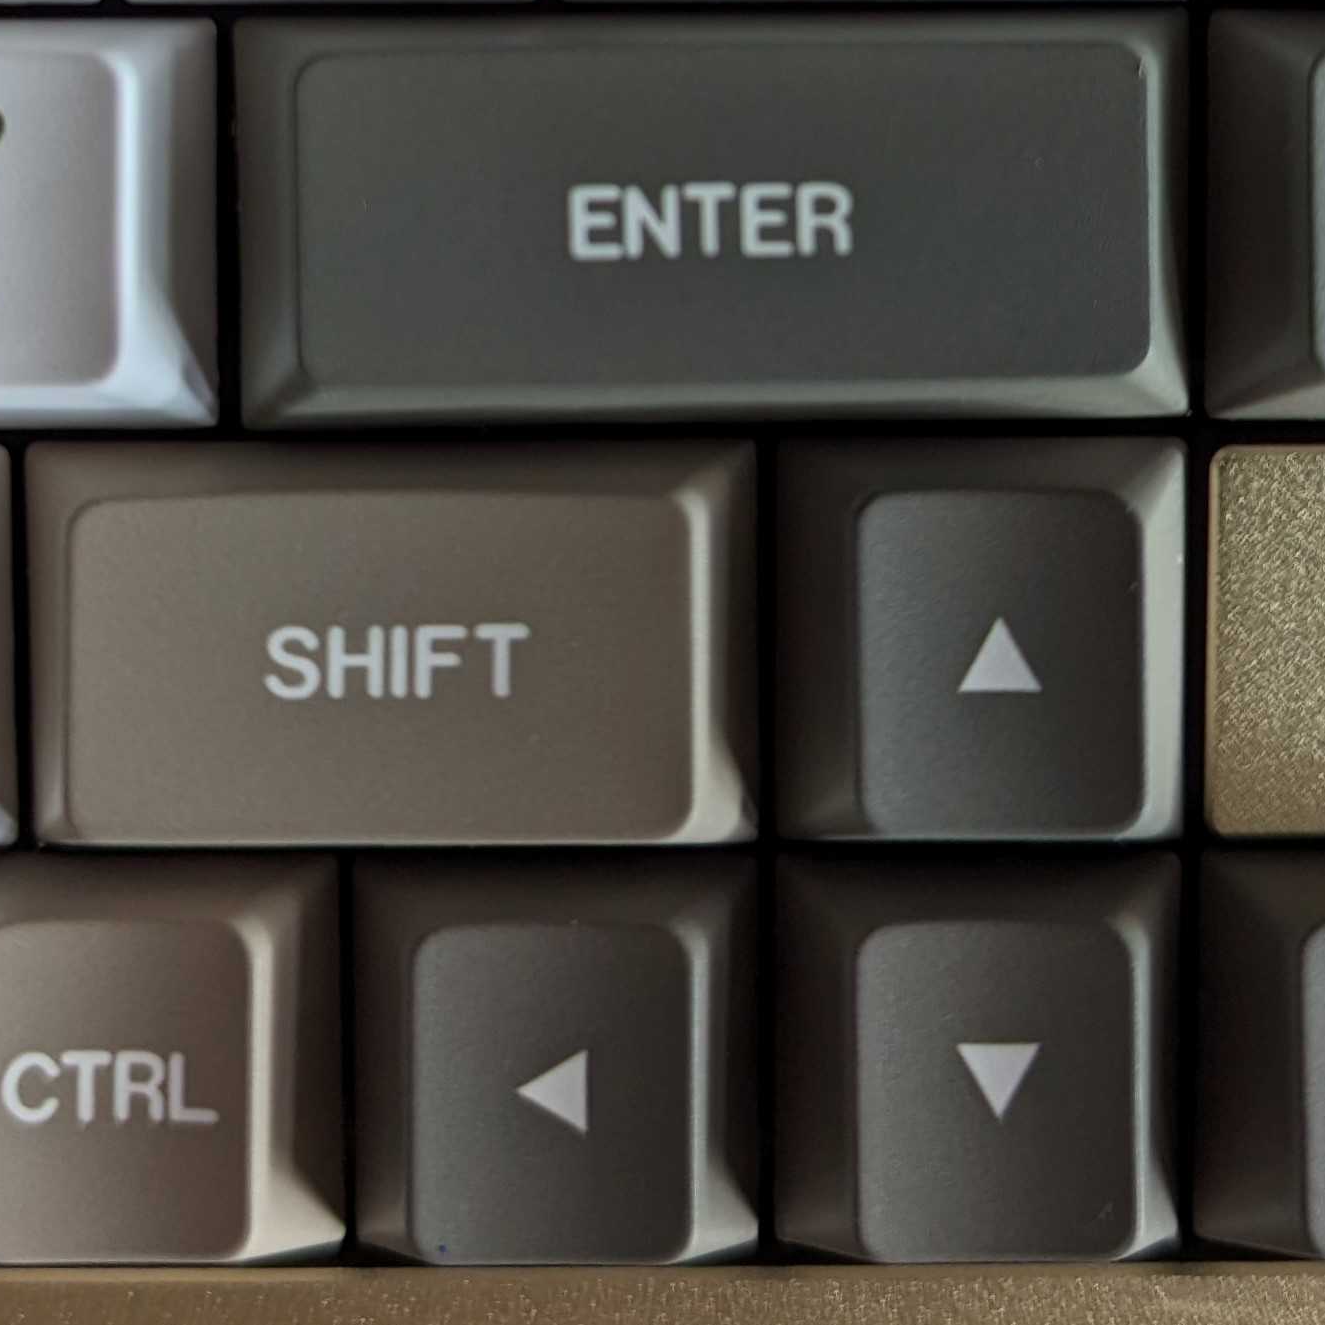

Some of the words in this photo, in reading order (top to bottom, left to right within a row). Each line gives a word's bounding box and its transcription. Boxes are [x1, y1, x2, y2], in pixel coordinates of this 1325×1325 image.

[567, 181, 854, 262] ENTER
[263, 622, 531, 700] SHIFT
[0, 1049, 219, 1125] CTRL
